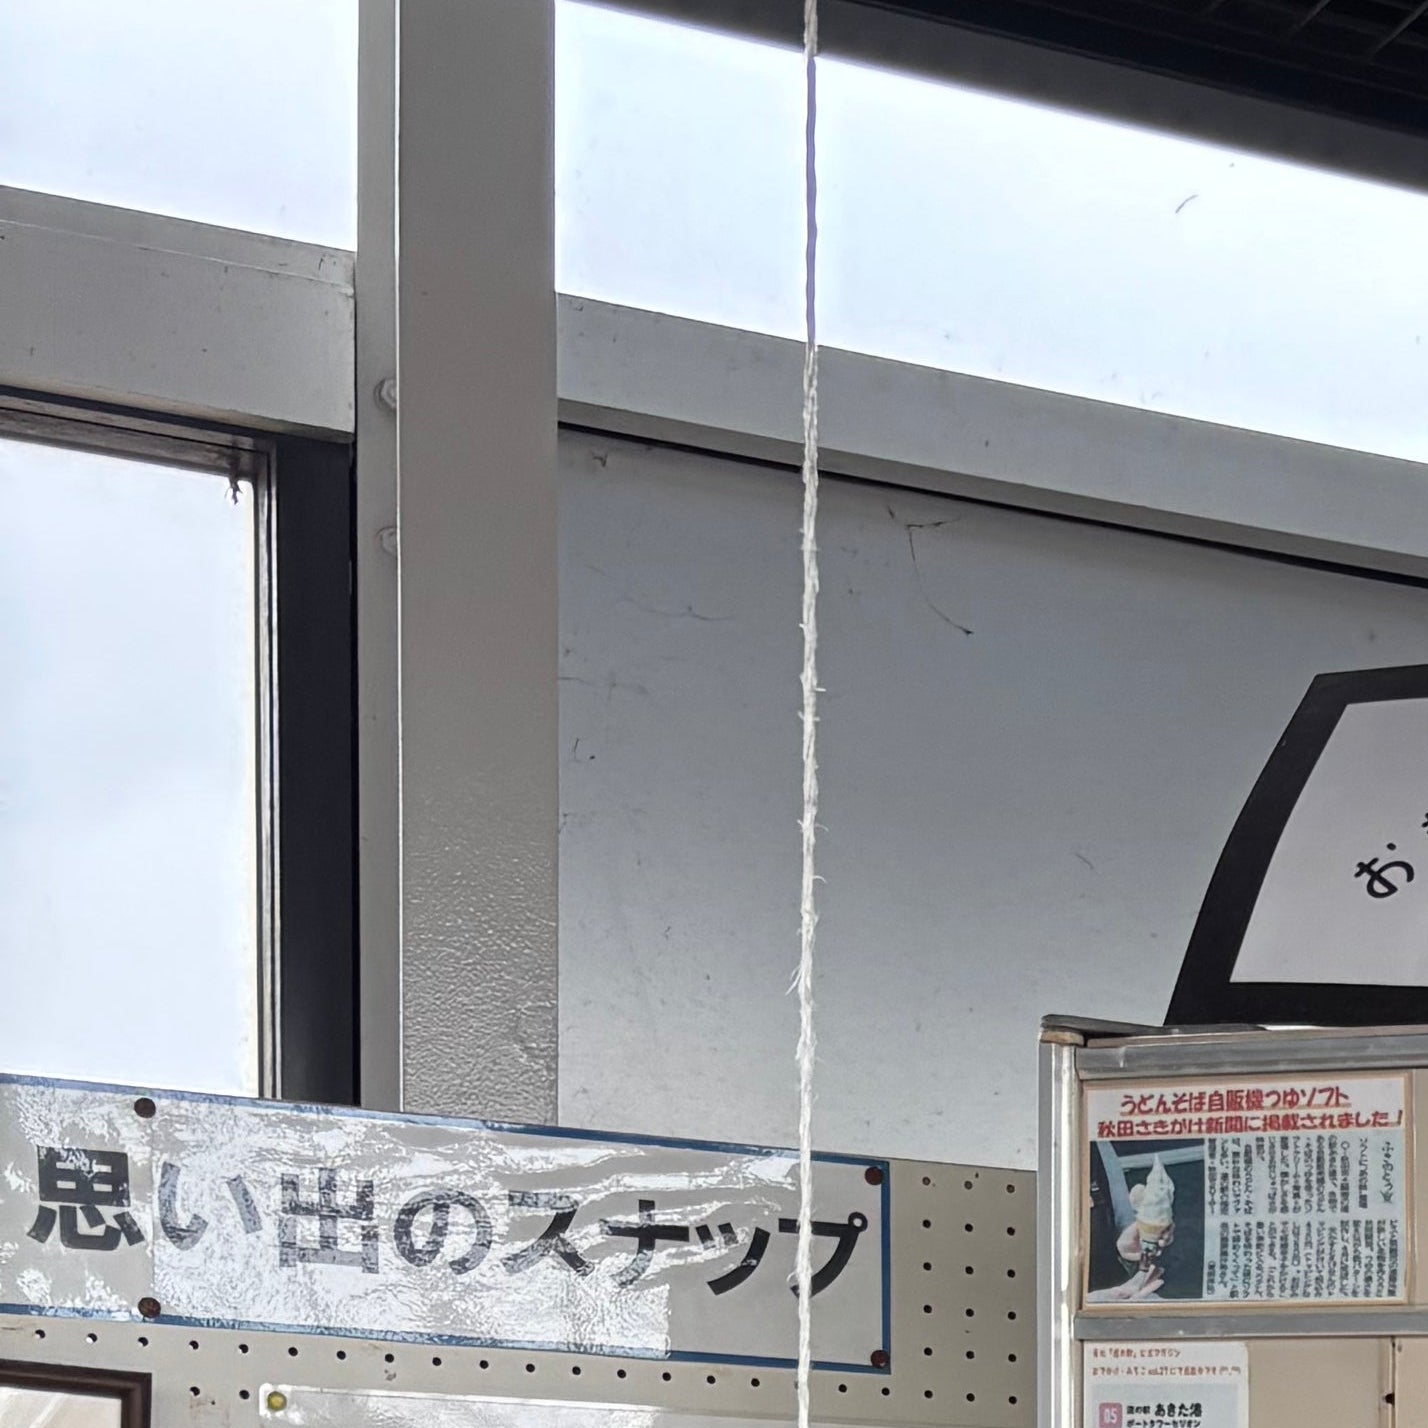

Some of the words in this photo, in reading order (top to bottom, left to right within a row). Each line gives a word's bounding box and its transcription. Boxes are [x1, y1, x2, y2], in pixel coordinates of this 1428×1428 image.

[27, 1143, 867, 1298] 思い出のスナップ
